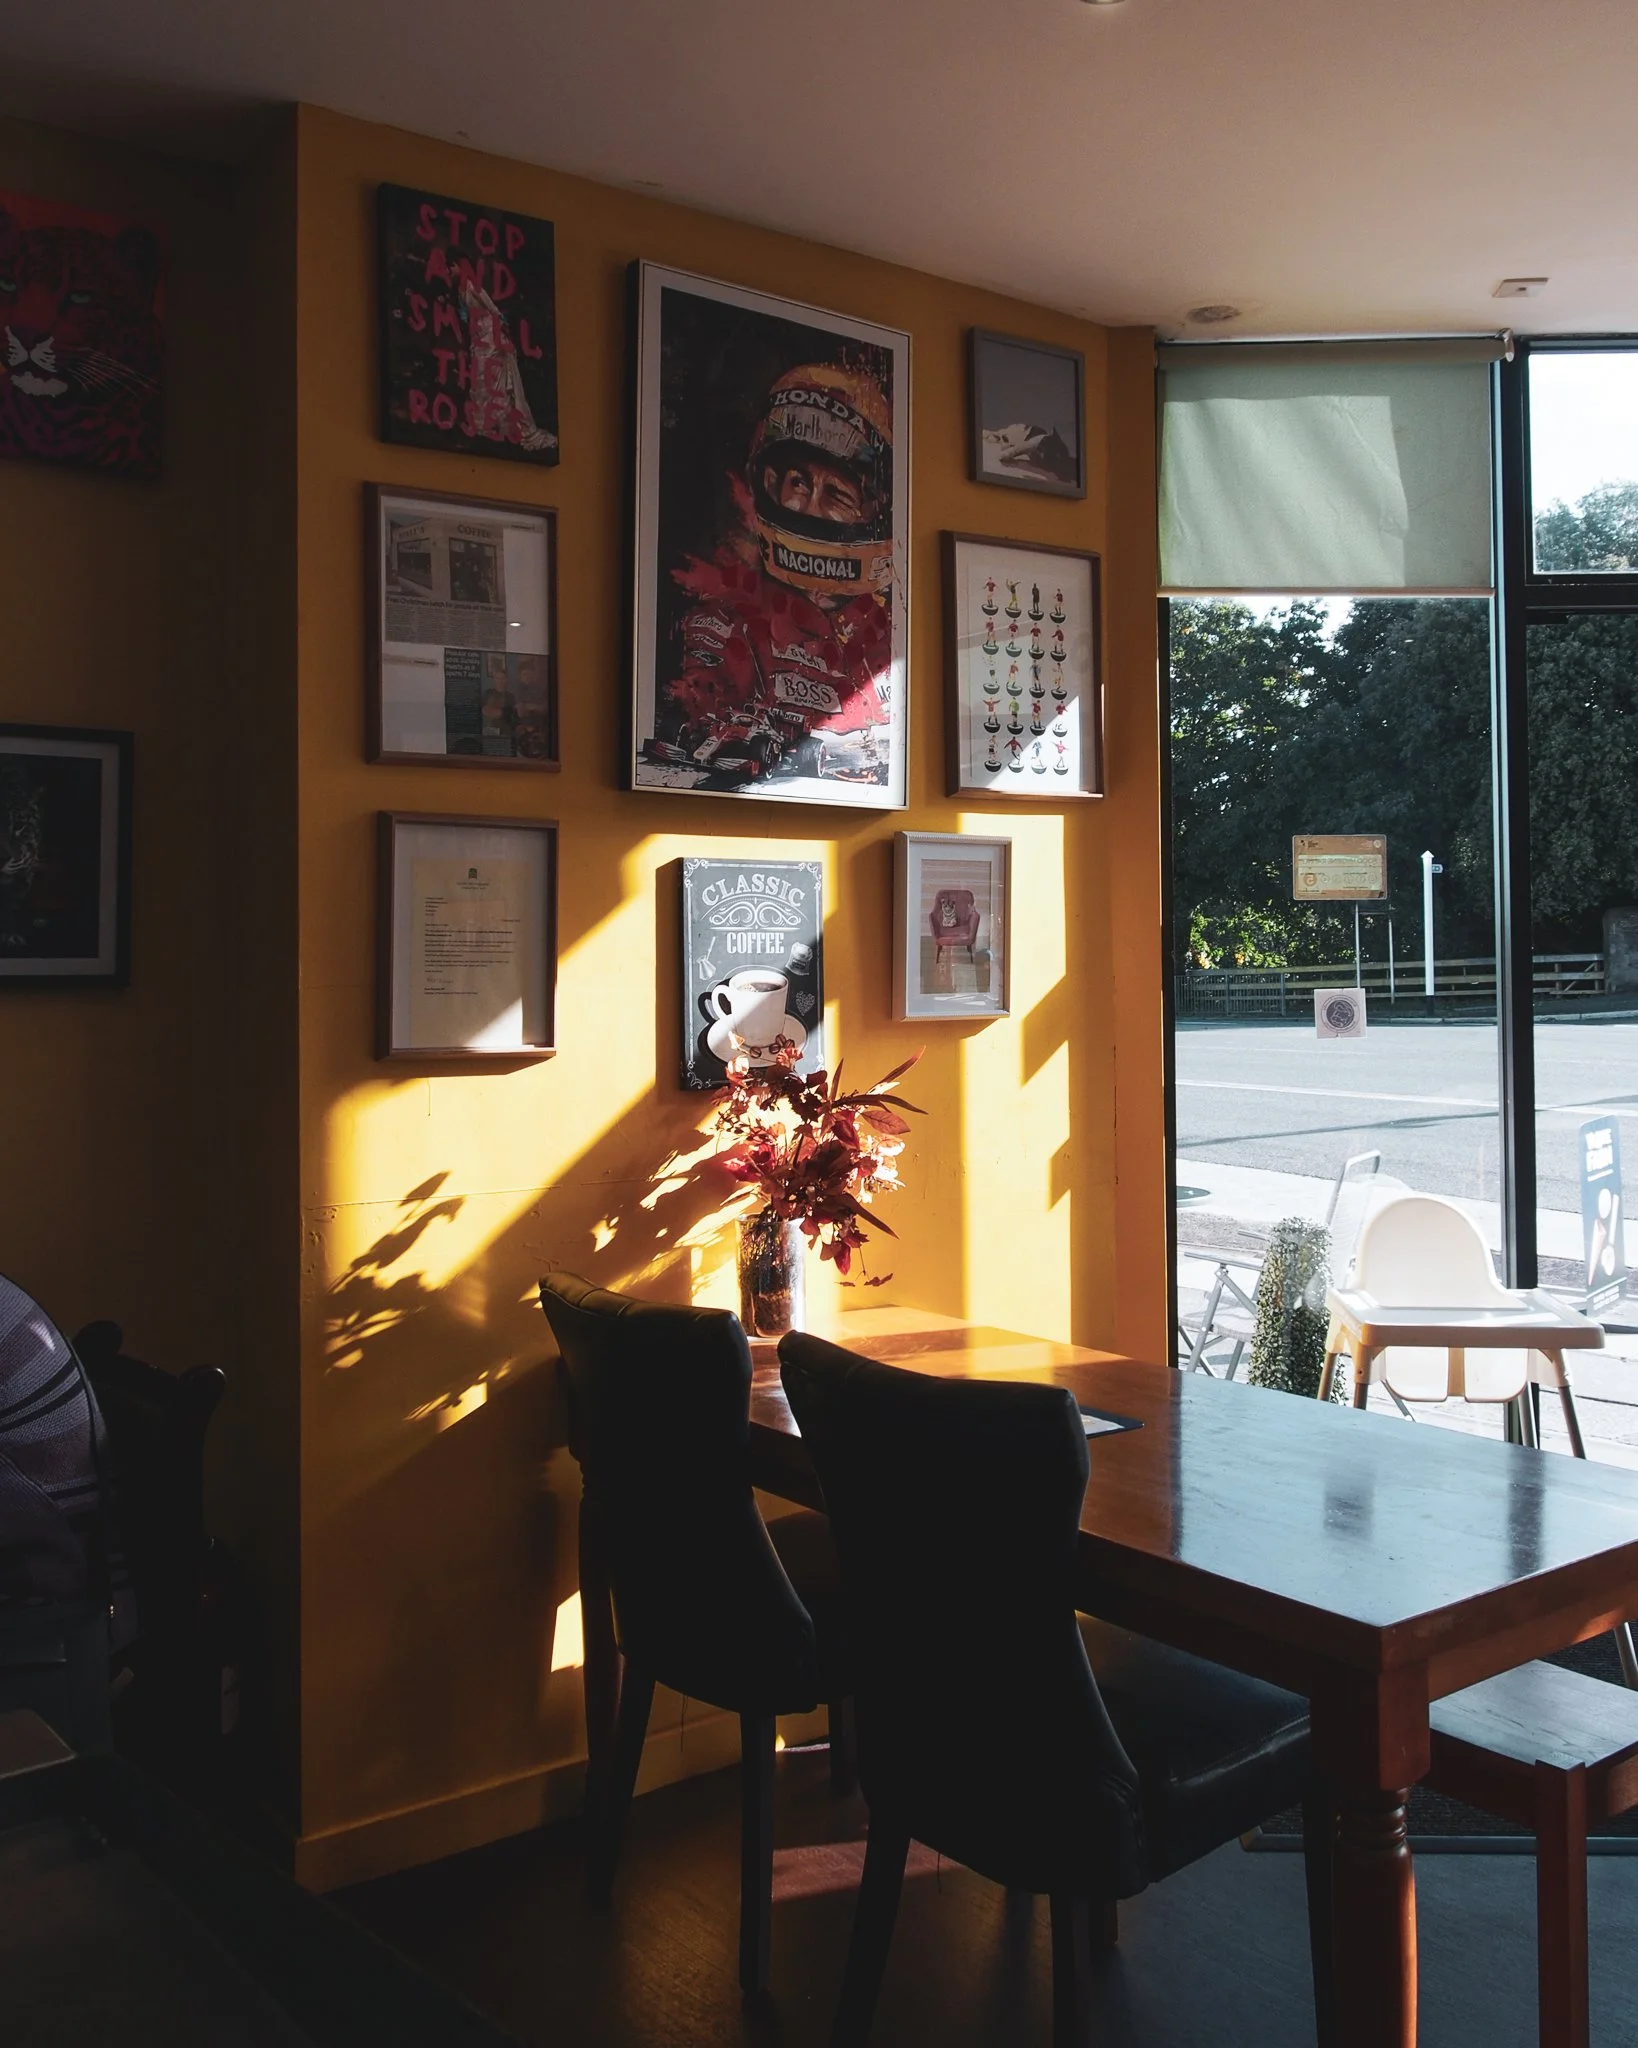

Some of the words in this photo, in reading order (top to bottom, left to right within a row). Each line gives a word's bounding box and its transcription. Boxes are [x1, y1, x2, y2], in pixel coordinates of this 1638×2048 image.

[416, 203, 525, 260] STOP
[425, 248, 516, 299] AND
[407, 294, 542, 359] SMELL
[431, 348, 505, 399] THE
[407, 388, 526, 444] ROSES
[773, 389, 866, 434] HONDA
[777, 548, 856, 578] NACIONAL
[783, 677, 832, 704] BOSS
[701, 872, 806, 908] CLASSIC
[726, 931, 785, 955] COFFEE
